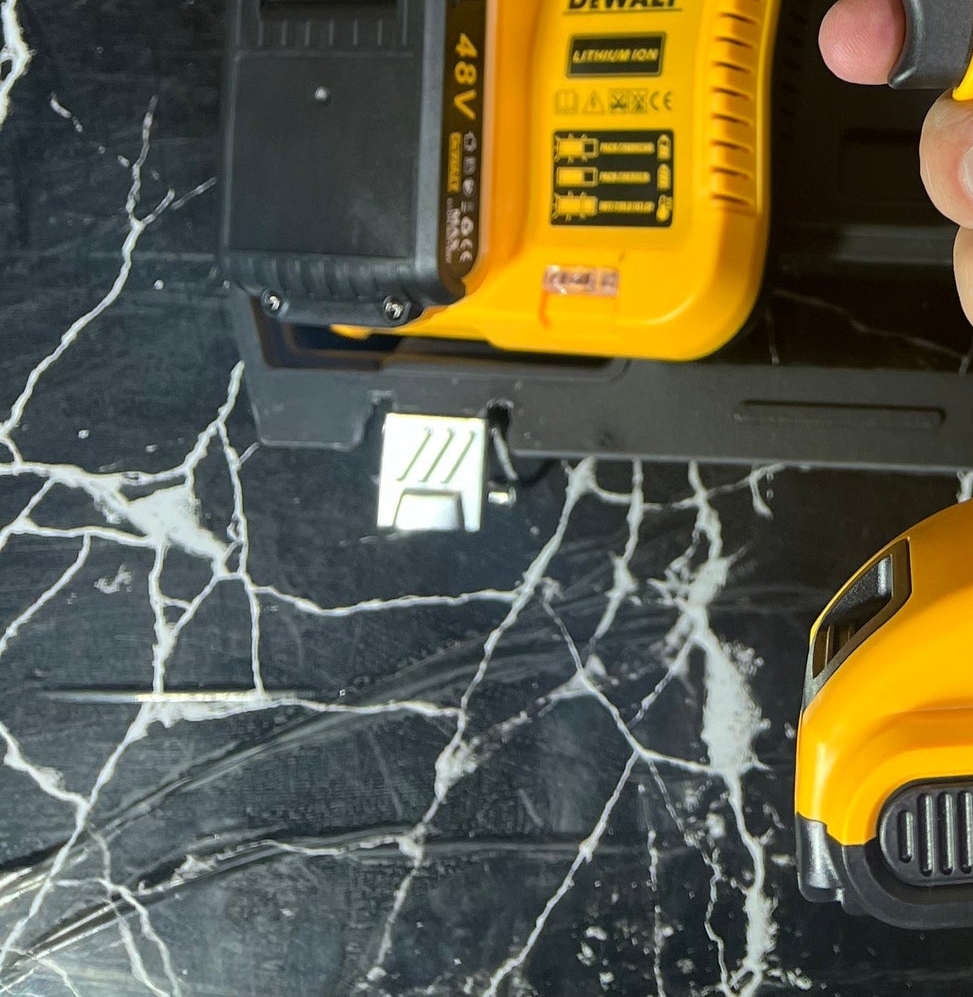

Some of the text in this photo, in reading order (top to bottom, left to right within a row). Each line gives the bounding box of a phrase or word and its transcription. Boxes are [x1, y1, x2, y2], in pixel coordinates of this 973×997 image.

[453, 32, 478, 120] 48V
[572, 48, 659, 64] LITHIUM ION
